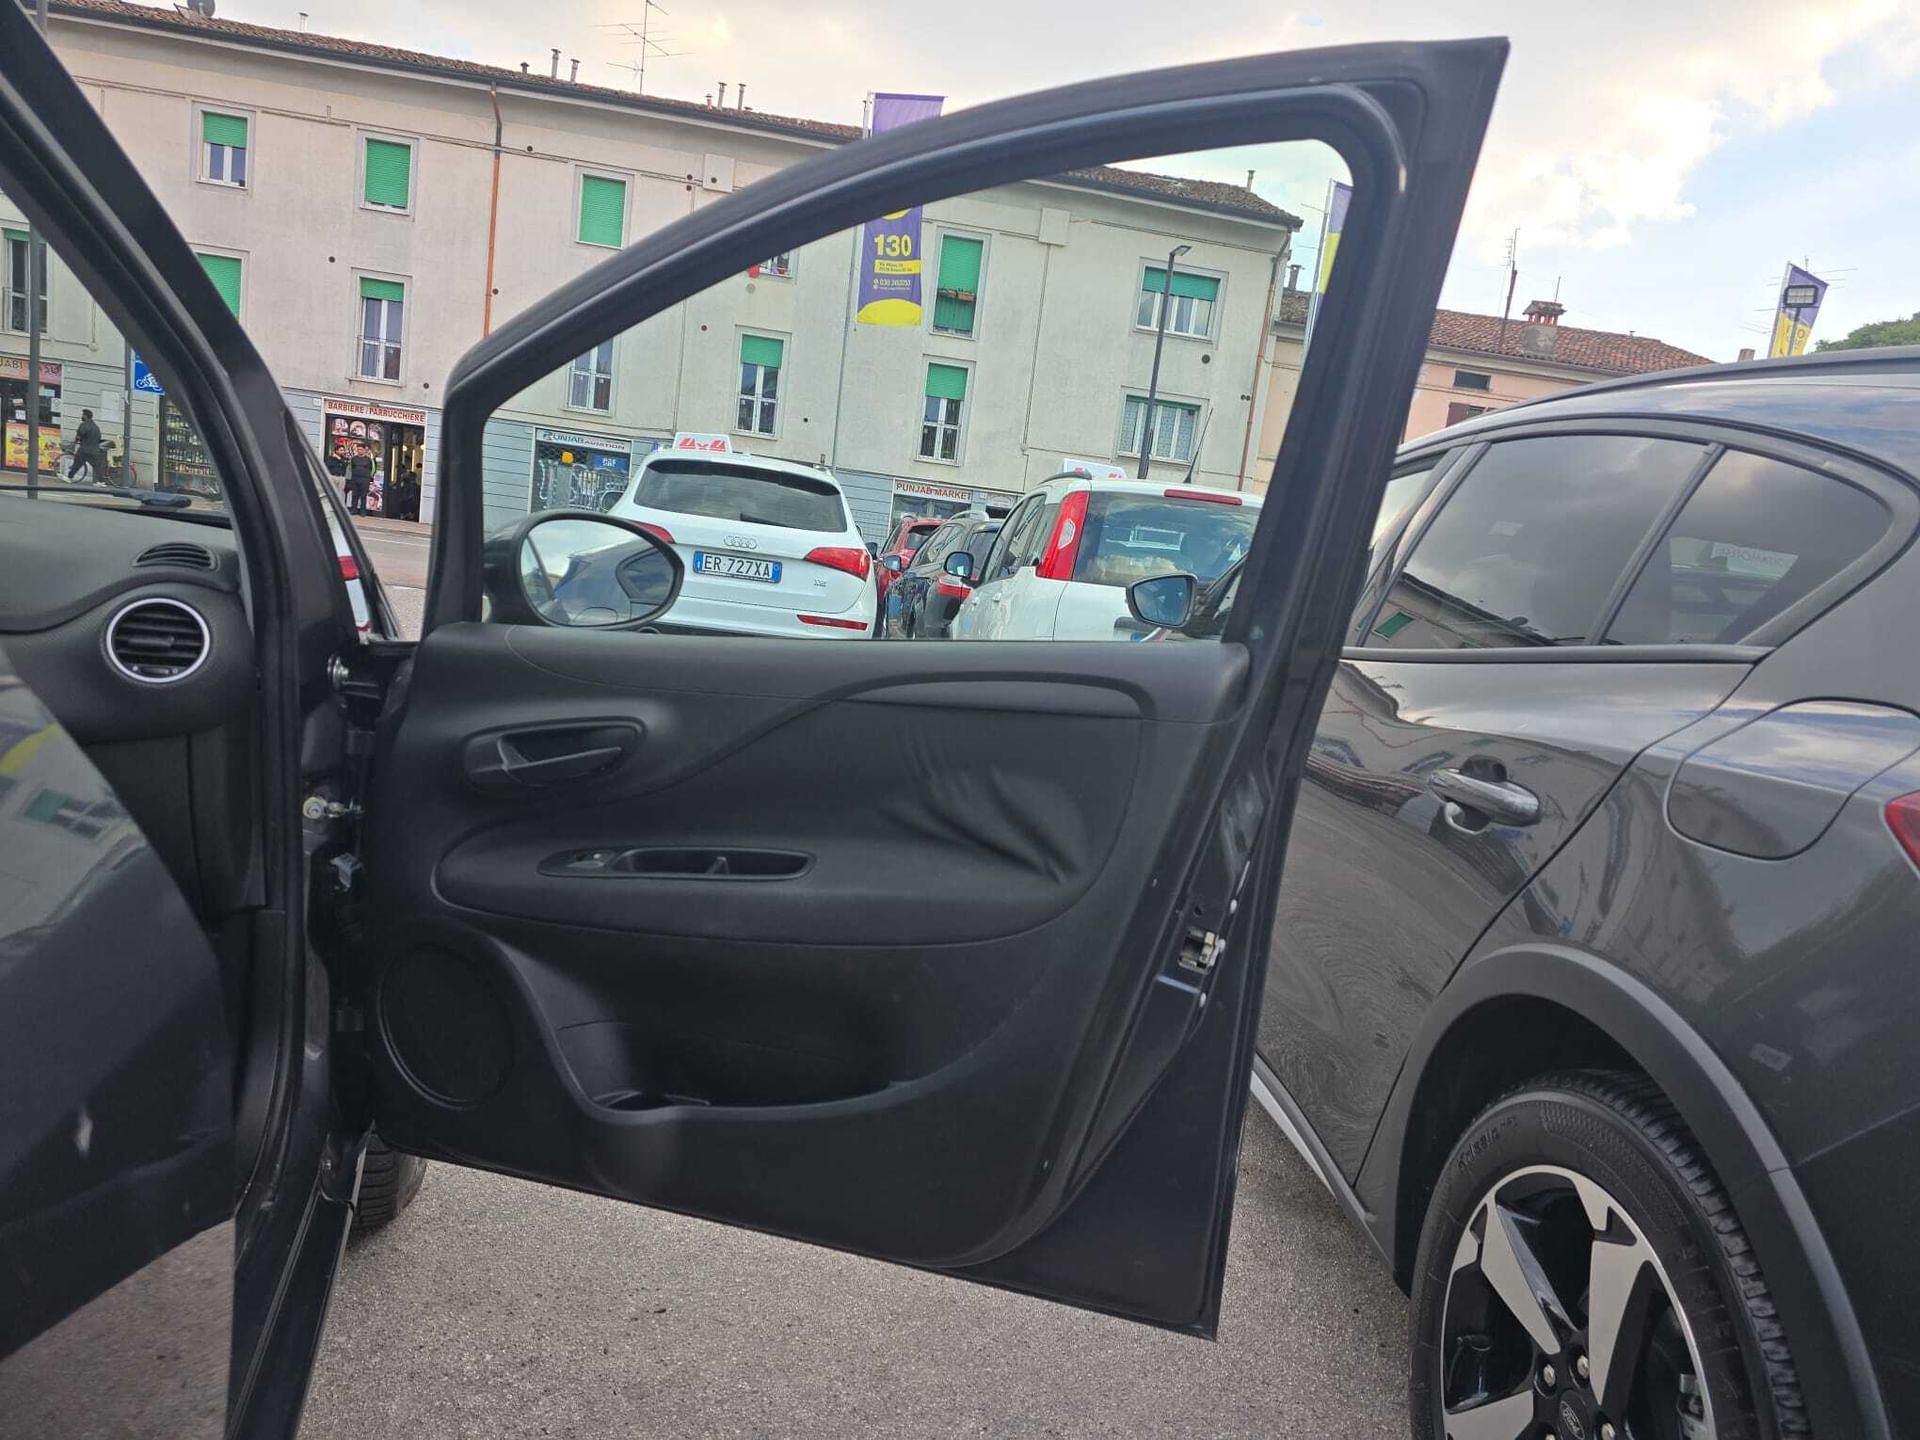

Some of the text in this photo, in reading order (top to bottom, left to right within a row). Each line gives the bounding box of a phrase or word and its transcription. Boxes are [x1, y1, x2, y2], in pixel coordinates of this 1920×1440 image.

[873, 233, 912, 257] 130
[327, 401, 365, 414] BARBIERE
[369, 407, 425, 422] PARRUCCHIERE
[896, 482, 933, 496] PUNJAB
[933, 486, 971, 501] MARKET
[704, 555, 770, 577] ER 727XA
